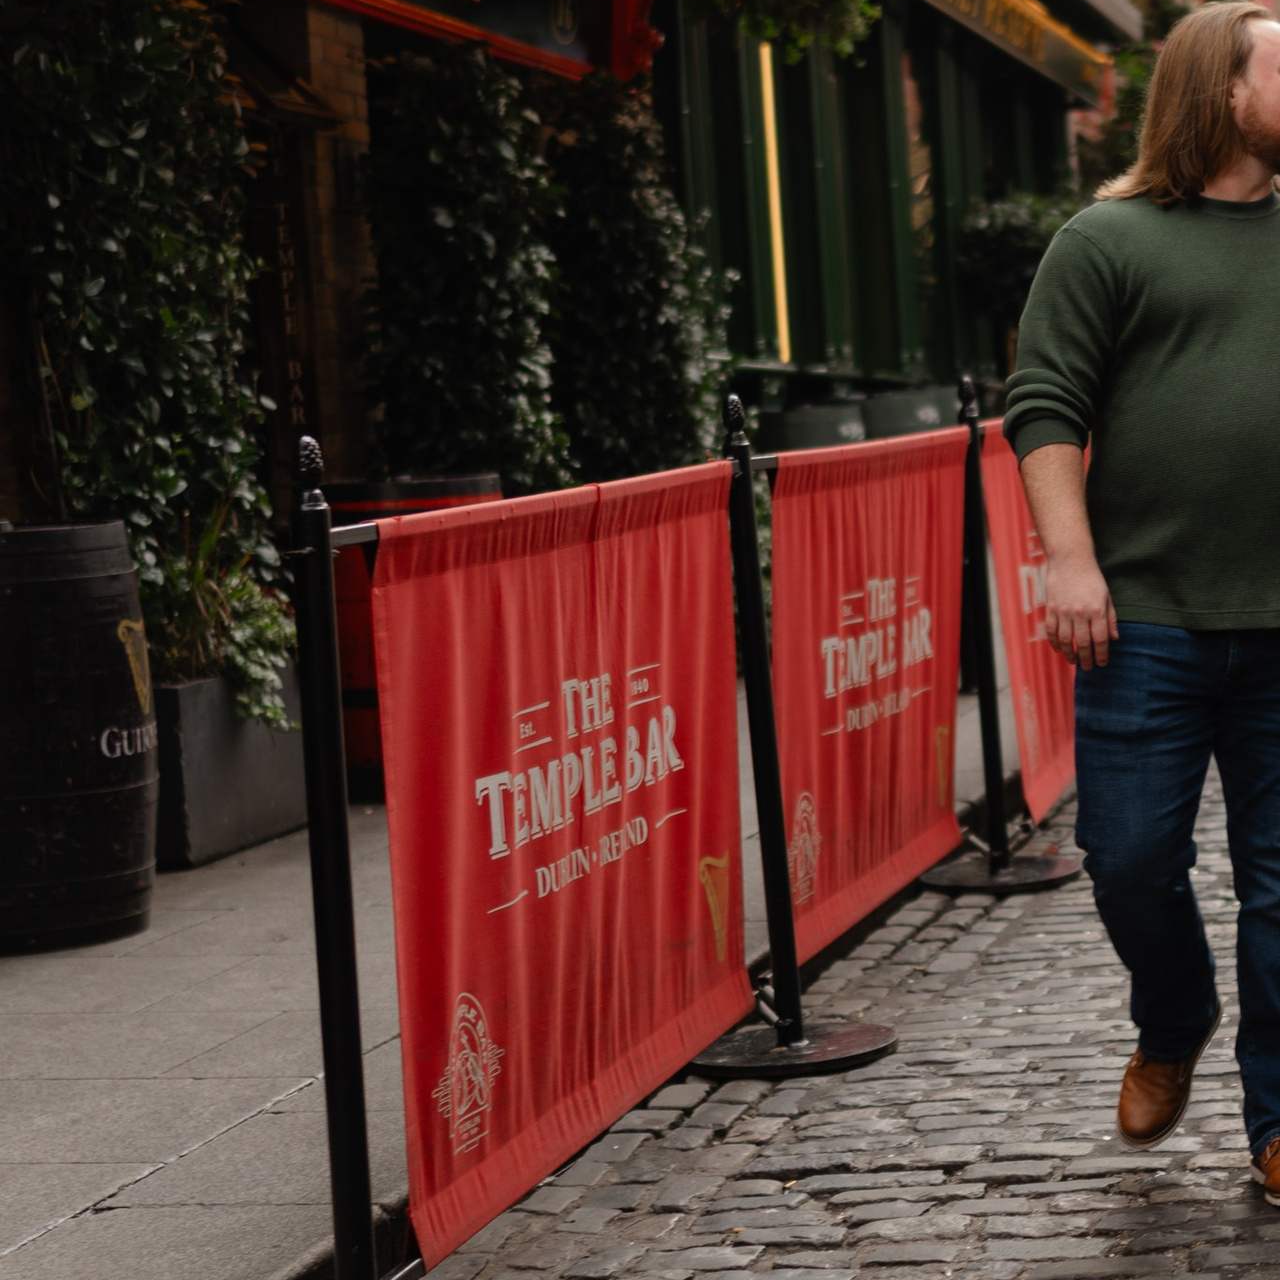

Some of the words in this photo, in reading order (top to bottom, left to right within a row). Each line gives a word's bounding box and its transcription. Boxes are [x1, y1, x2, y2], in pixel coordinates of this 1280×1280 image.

[274, 202, 299, 336] TEMPLE
[287, 359, 306, 425] BAR
[867, 578, 896, 622] THE
[821, 624, 897, 699] TEMPLE
[519, 721, 536, 739] Est.
[561, 672, 615, 739] THE
[475, 737, 622, 860] TEMPLE
[626, 705, 685, 794] BAR
